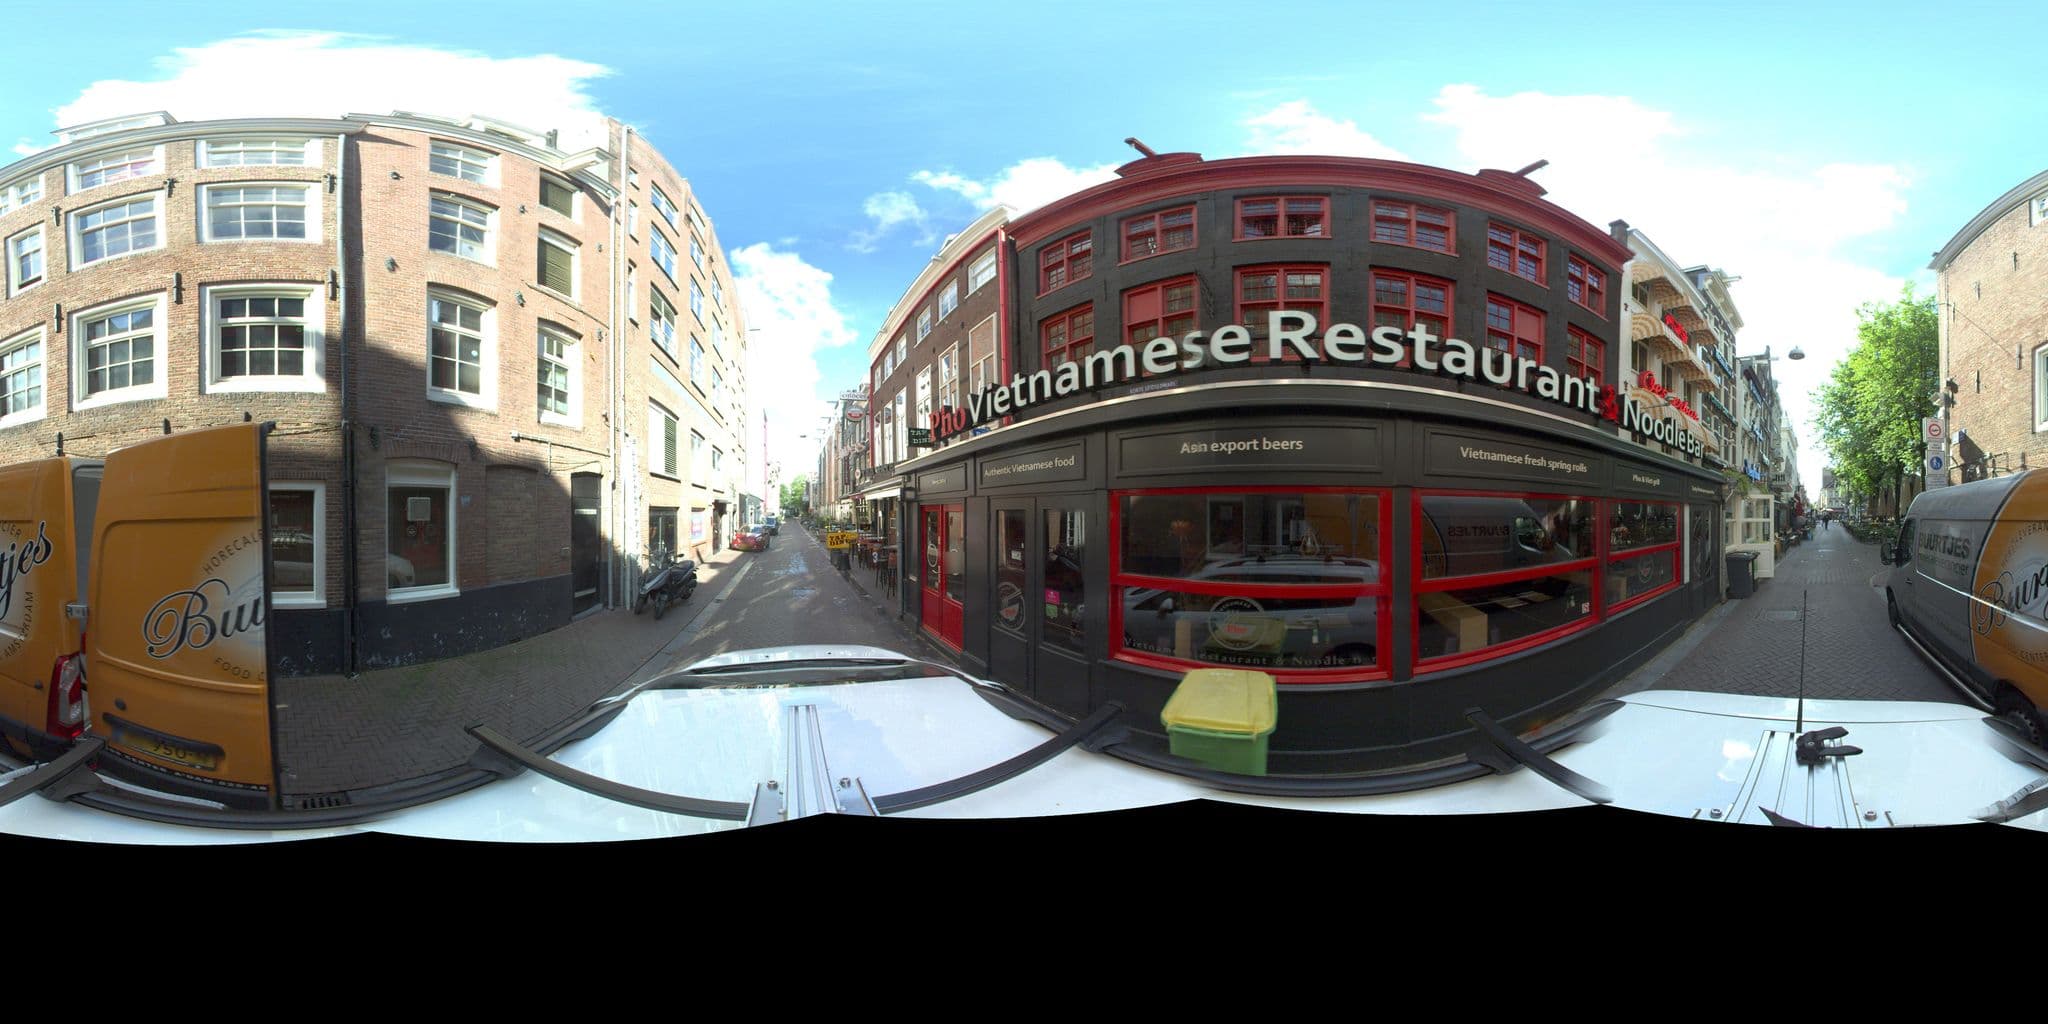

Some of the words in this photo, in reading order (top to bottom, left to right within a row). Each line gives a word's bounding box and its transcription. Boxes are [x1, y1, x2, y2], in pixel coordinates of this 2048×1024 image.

[929, 405, 967, 442] Pho
[967, 324, 1251, 424] Vietnamese
[1269, 309, 1601, 415] Restaurant
[1600, 385, 1619, 423] &
[1210, 438, 1260, 455] export
[1262, 437, 1304, 450] beers
[984, 465, 1012, 477] Authentic
[1012, 460, 1054, 473] Vietnamese
[1054, 455, 1075, 467] food
[1460, 446, 1524, 464] Vietnamese
[1524, 455, 1547, 467] fresh
[1547, 460, 1572, 473] spring
